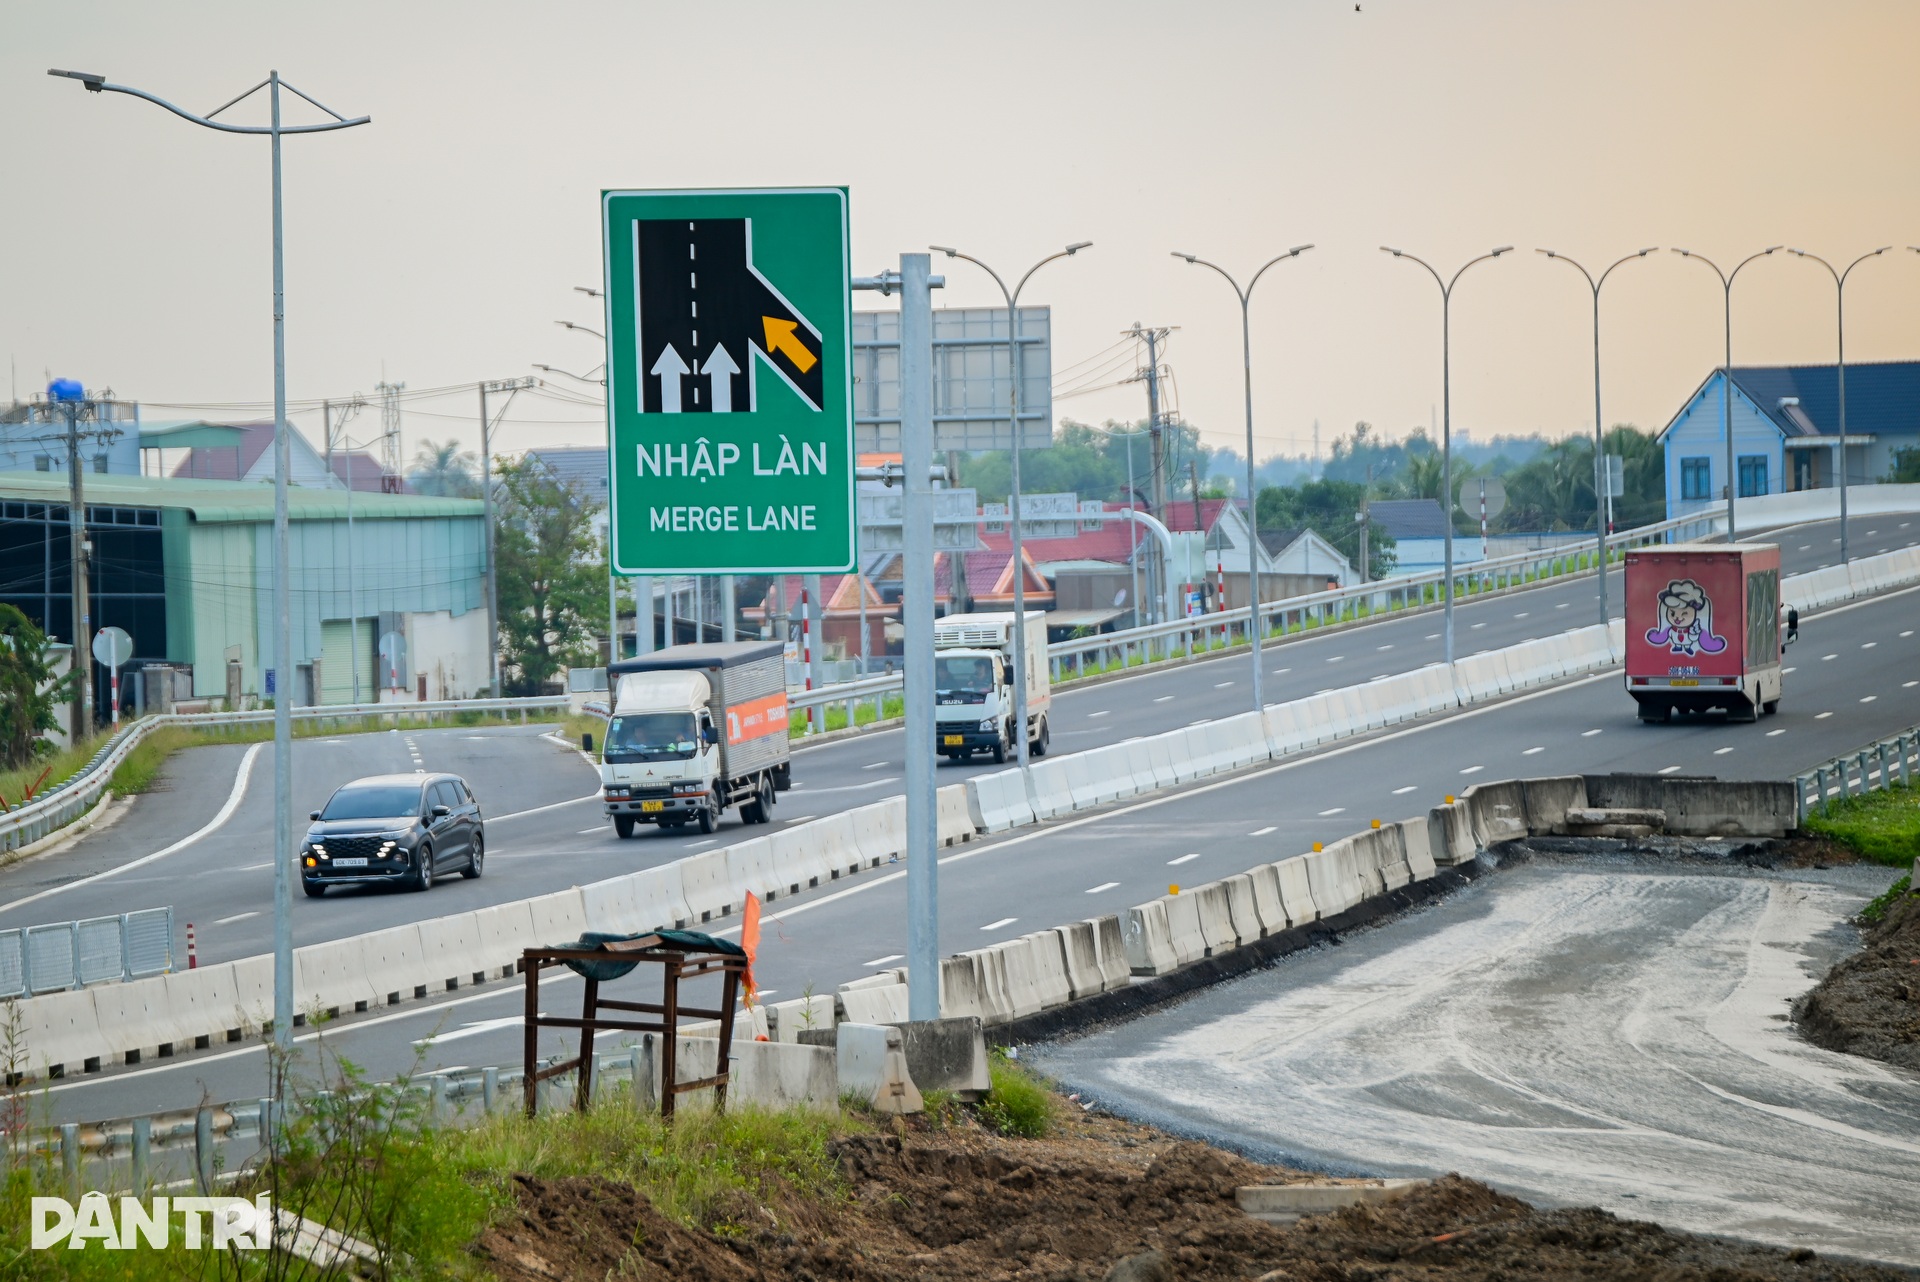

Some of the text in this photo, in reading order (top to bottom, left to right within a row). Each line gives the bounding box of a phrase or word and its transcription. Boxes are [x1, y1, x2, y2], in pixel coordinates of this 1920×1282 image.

[636, 434, 827, 482] NHẬP LÀN
[650, 505, 816, 532] MERGE LANE
[767, 705, 786, 722] TOSHIBA
